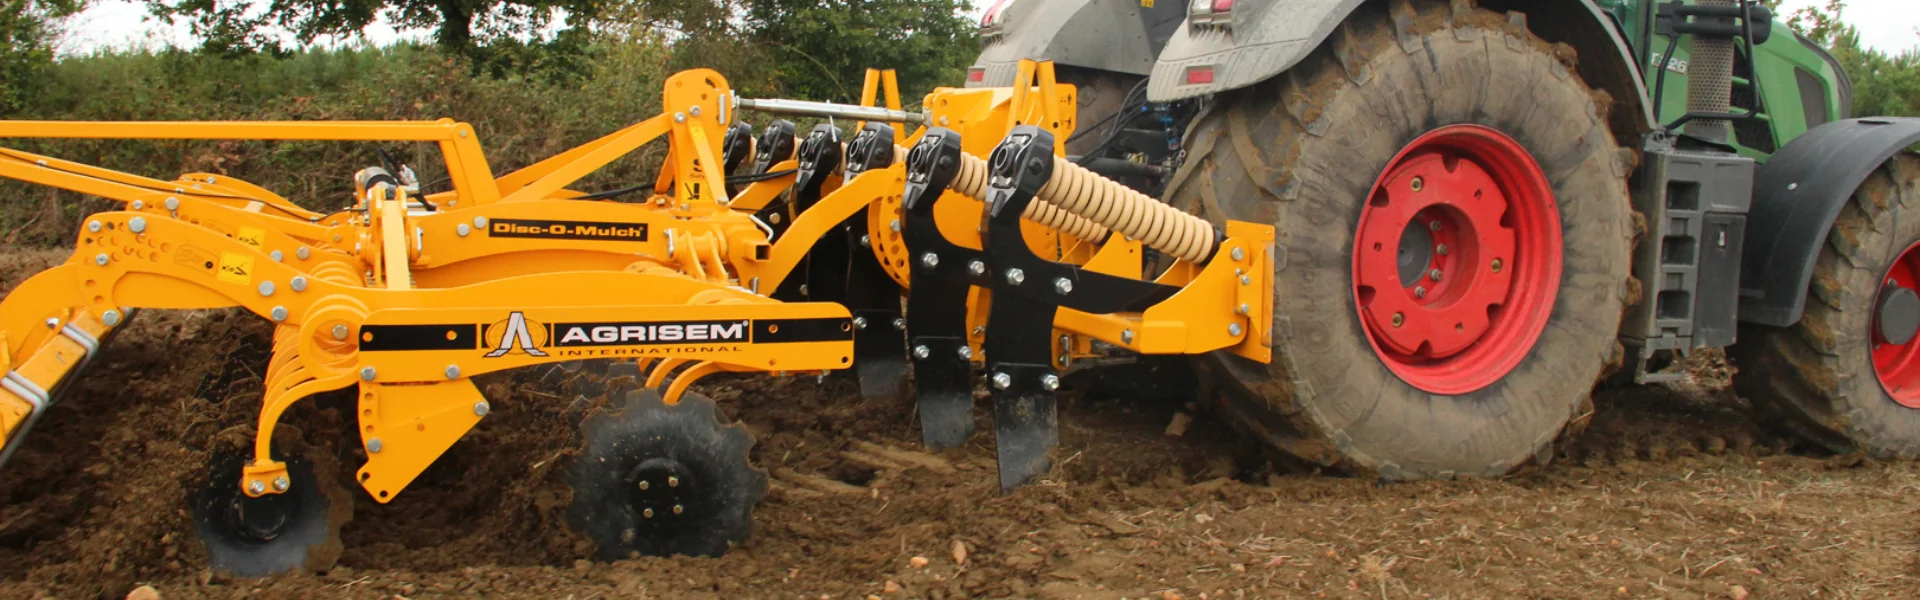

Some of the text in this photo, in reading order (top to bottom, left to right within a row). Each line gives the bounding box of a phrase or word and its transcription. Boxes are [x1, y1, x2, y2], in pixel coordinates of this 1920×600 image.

[493, 222, 641, 237] Disc-O-Mulch
[560, 324, 743, 343] AGRISEM
[559, 346, 742, 356] INTERNATIONAL
